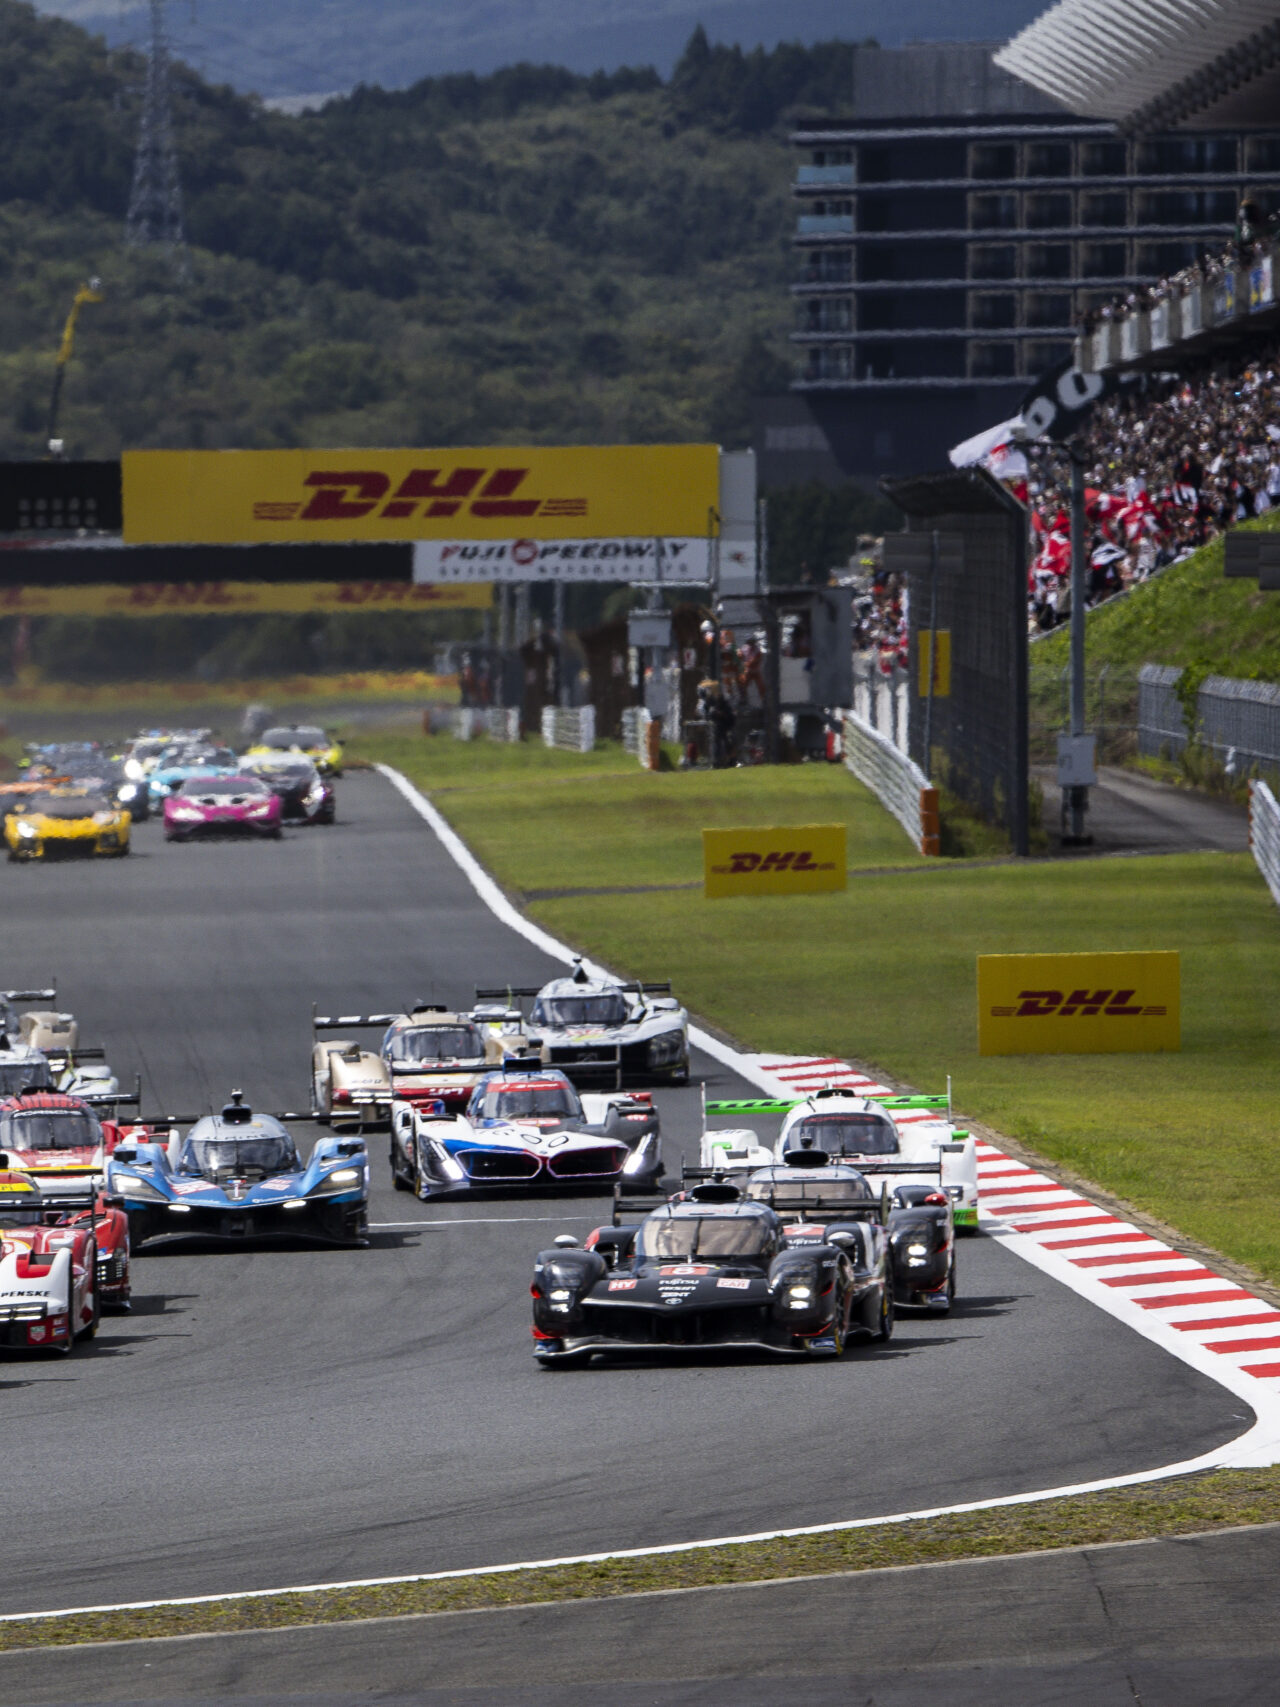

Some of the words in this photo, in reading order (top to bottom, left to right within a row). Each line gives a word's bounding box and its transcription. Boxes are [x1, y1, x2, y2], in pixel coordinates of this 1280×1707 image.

[299, 468, 542, 520] DHL
[440, 545, 506, 561] FUJI
[730, 851, 818, 873] DHL
[1016, 989, 1144, 1017] DHL
[673, 1266, 696, 1275] 8
[611, 1281, 634, 1290] HY
[659, 1278, 699, 1286] FUJITSU
[722, 1281, 749, 1289] CAR
[1, 1290, 51, 1298] PENSKE
